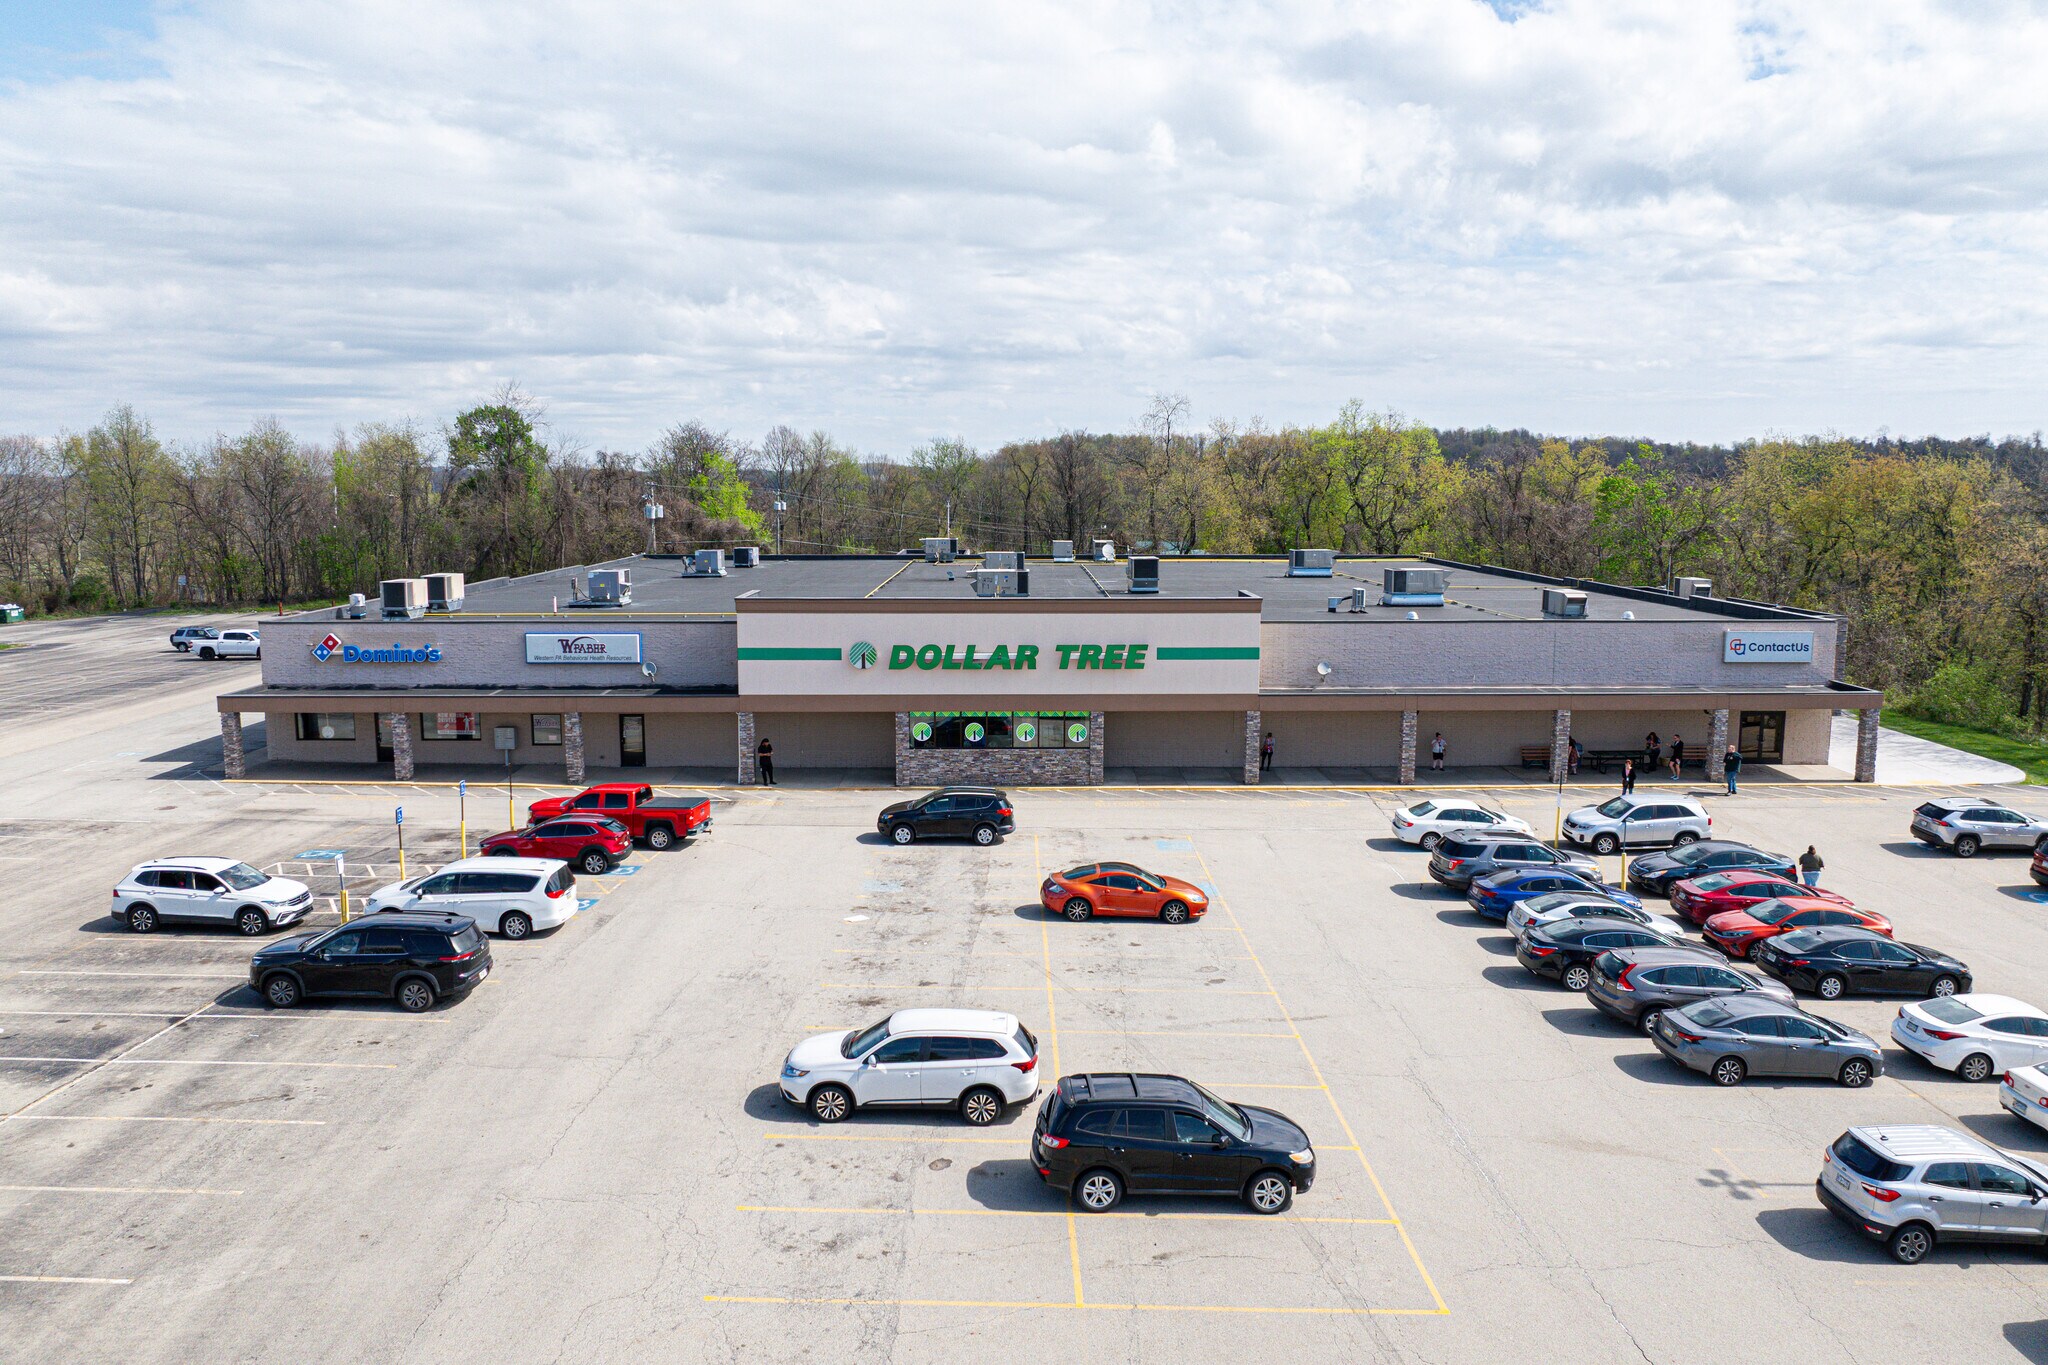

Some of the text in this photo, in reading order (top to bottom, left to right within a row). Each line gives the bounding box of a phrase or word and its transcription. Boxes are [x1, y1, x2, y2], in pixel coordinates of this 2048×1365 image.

[343, 643, 442, 663] Domino's
[888, 644, 1149, 670] DOLLAR TREE
[1748, 642, 1810, 652] ContactUs
